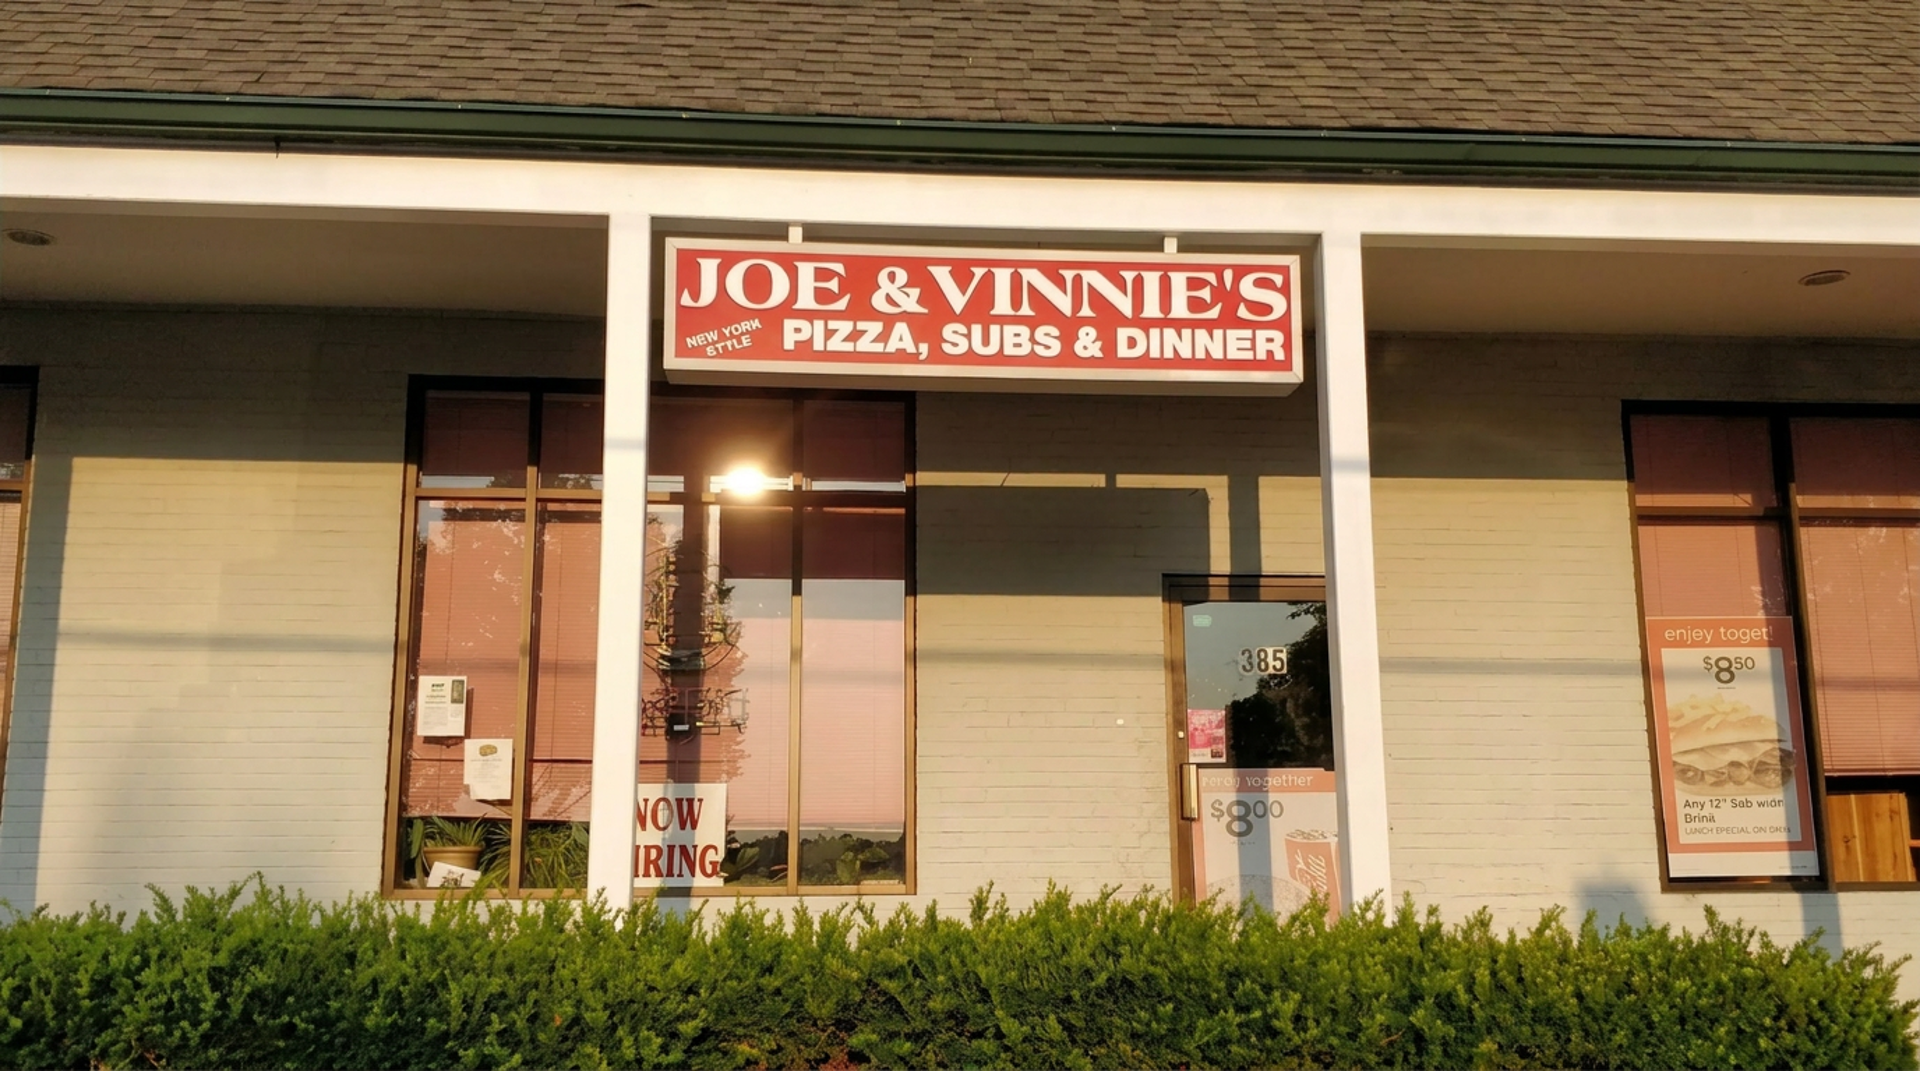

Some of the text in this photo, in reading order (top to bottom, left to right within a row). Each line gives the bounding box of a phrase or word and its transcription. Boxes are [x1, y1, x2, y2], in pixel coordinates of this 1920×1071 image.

[680, 257, 1288, 322] JOE & VINNIE'S
[685, 318, 762, 348] NEW YORK
[782, 318, 1286, 361] PIZZA, SUBS & DINNER
[1241, 648, 1285, 673] 385
[636, 797, 704, 832] NOW
[1683, 799, 1706, 811] Any
[634, 844, 720, 878] IRING
